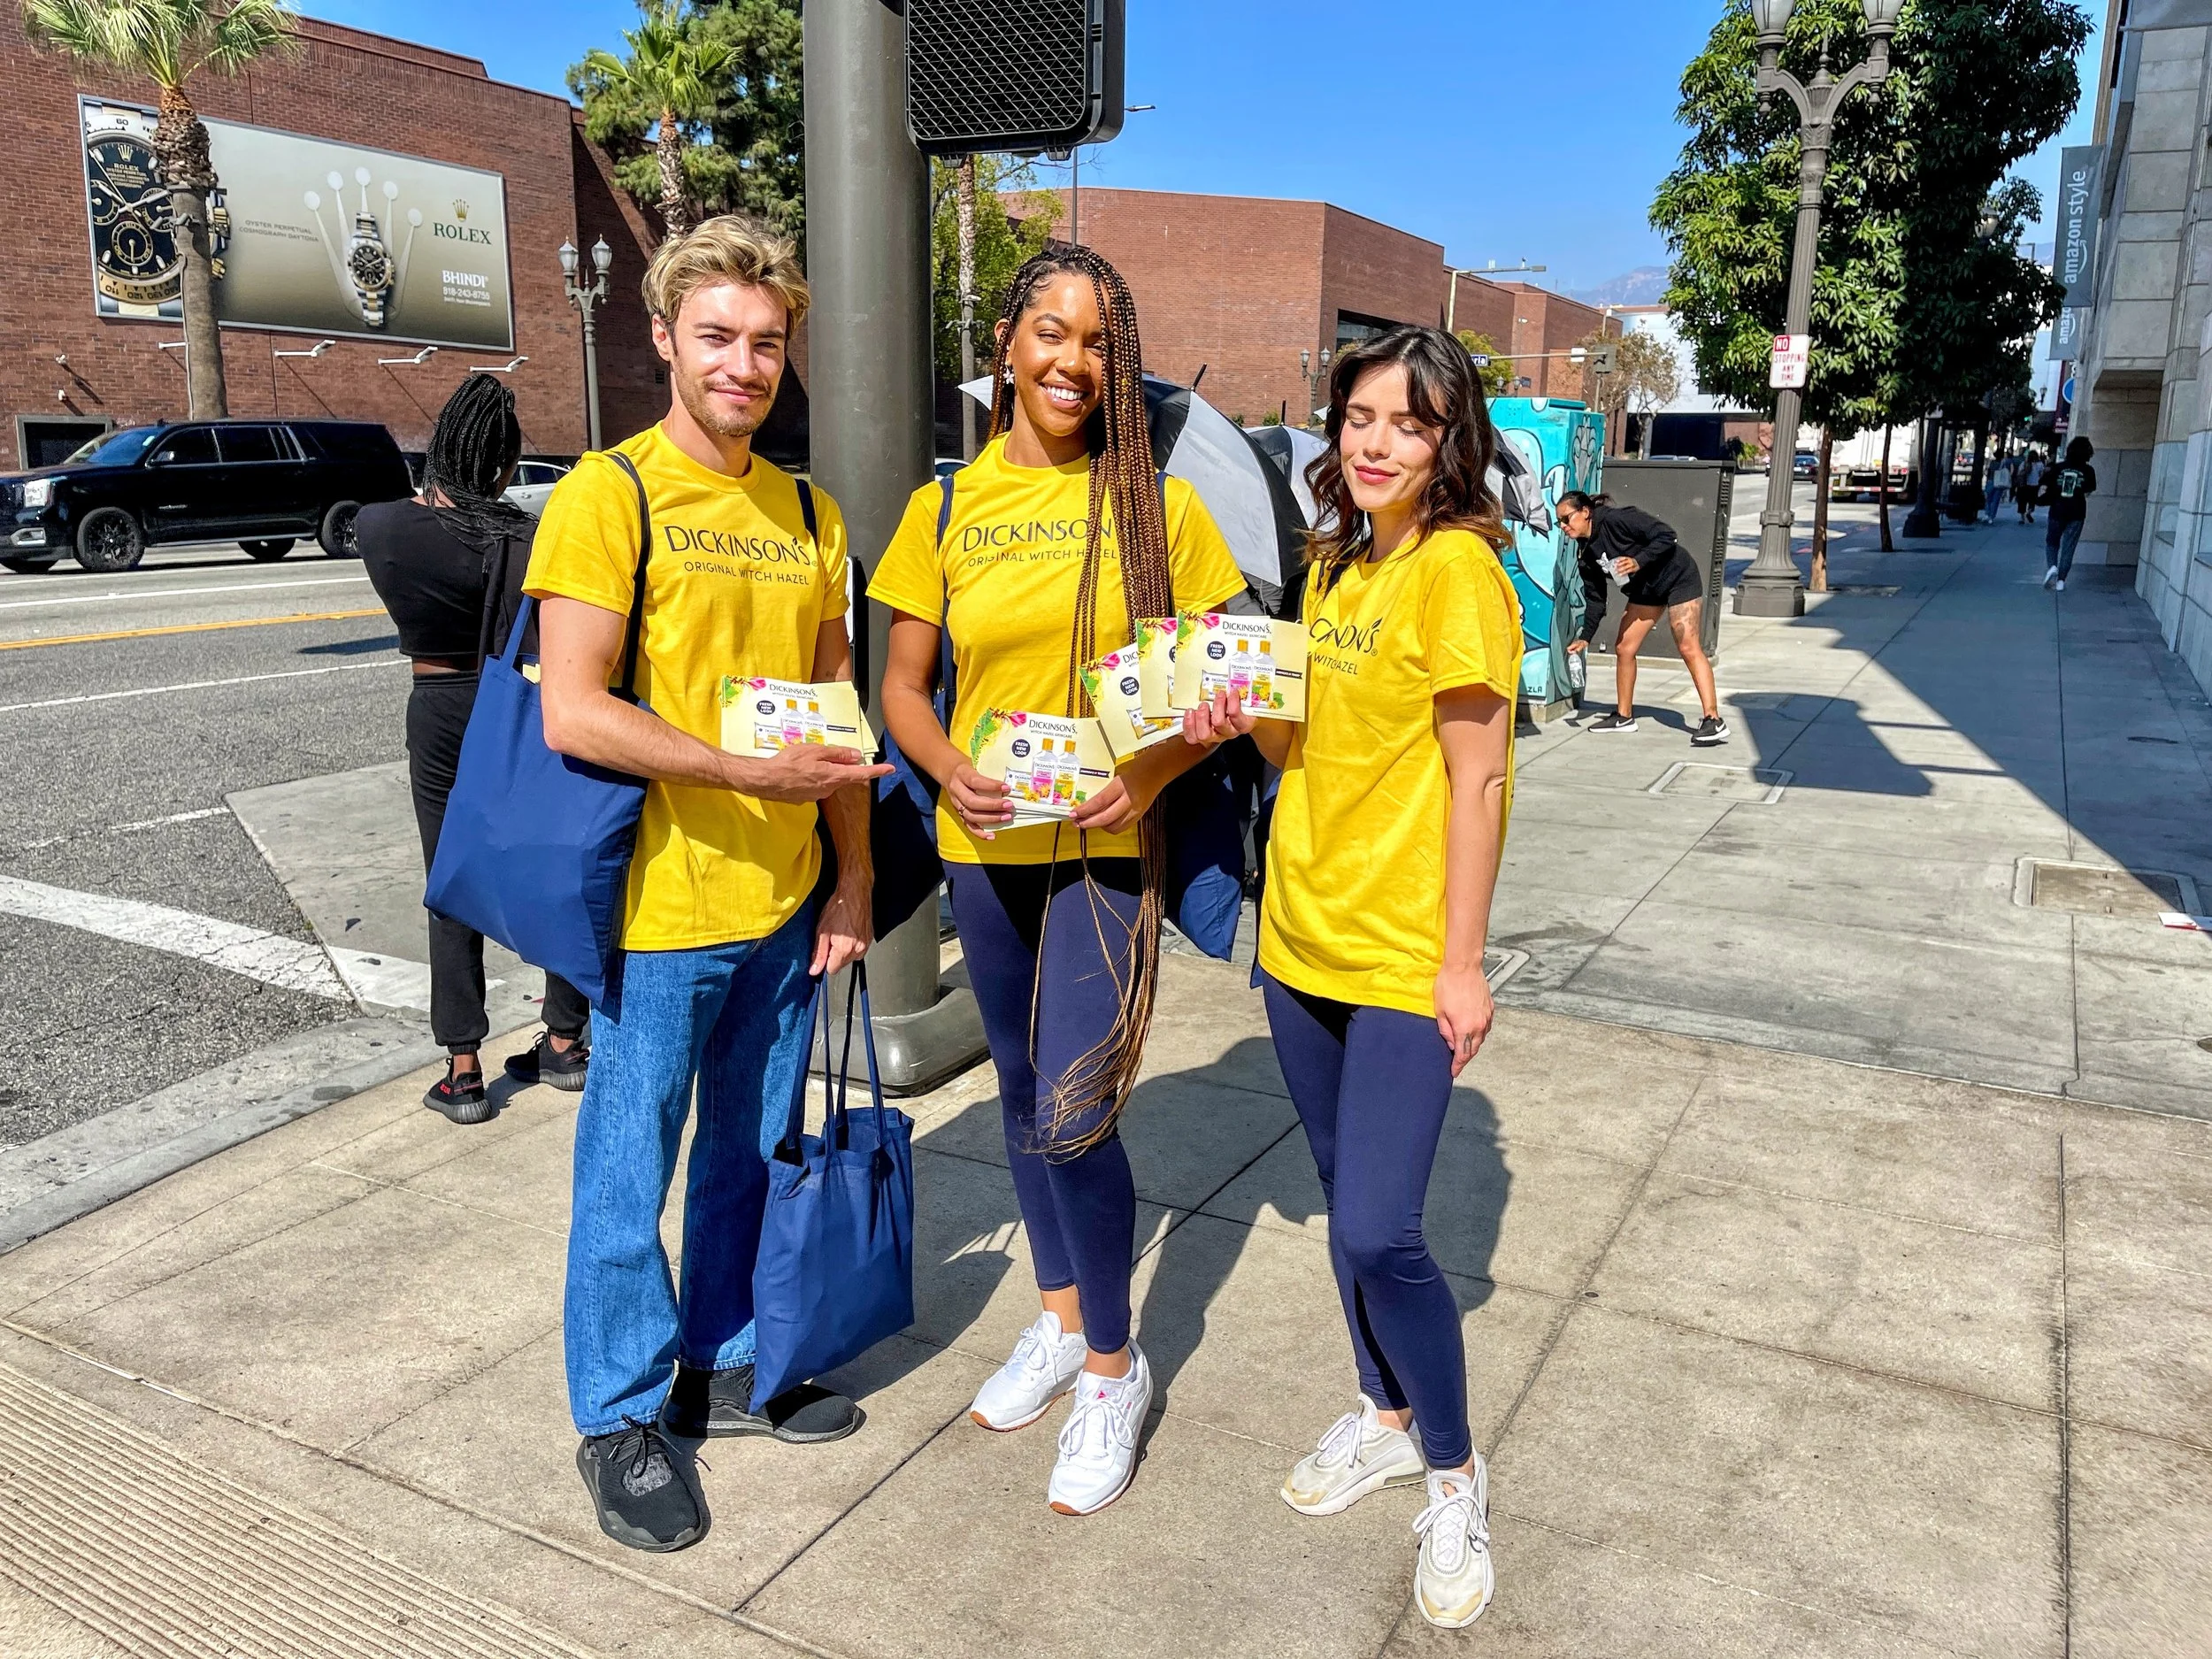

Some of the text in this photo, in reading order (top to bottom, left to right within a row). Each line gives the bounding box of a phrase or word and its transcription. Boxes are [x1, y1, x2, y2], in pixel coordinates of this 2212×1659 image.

[113, 163, 139, 172] ROLEX
[245, 219, 272, 229] OYSTER
[2064, 171, 2089, 284] amazon style
[433, 222, 492, 245] ROLEX
[442, 270, 486, 288] BHINDI
[2059, 306, 2072, 344] amazo
[1776, 338, 1788, 350] NO
[1775, 353, 1805, 363] STOPPING
[1029, 549, 1071, 561] WITCH
[1076, 549, 1118, 559] HEL
[684, 561, 809, 586] ORIGINAL WITCH HAZEL
[1222, 621, 1270, 634] DICKINSON'S
[769, 683, 817, 696] DICKINSON'S
[1029, 719, 1076, 733] DICKINSON'S
